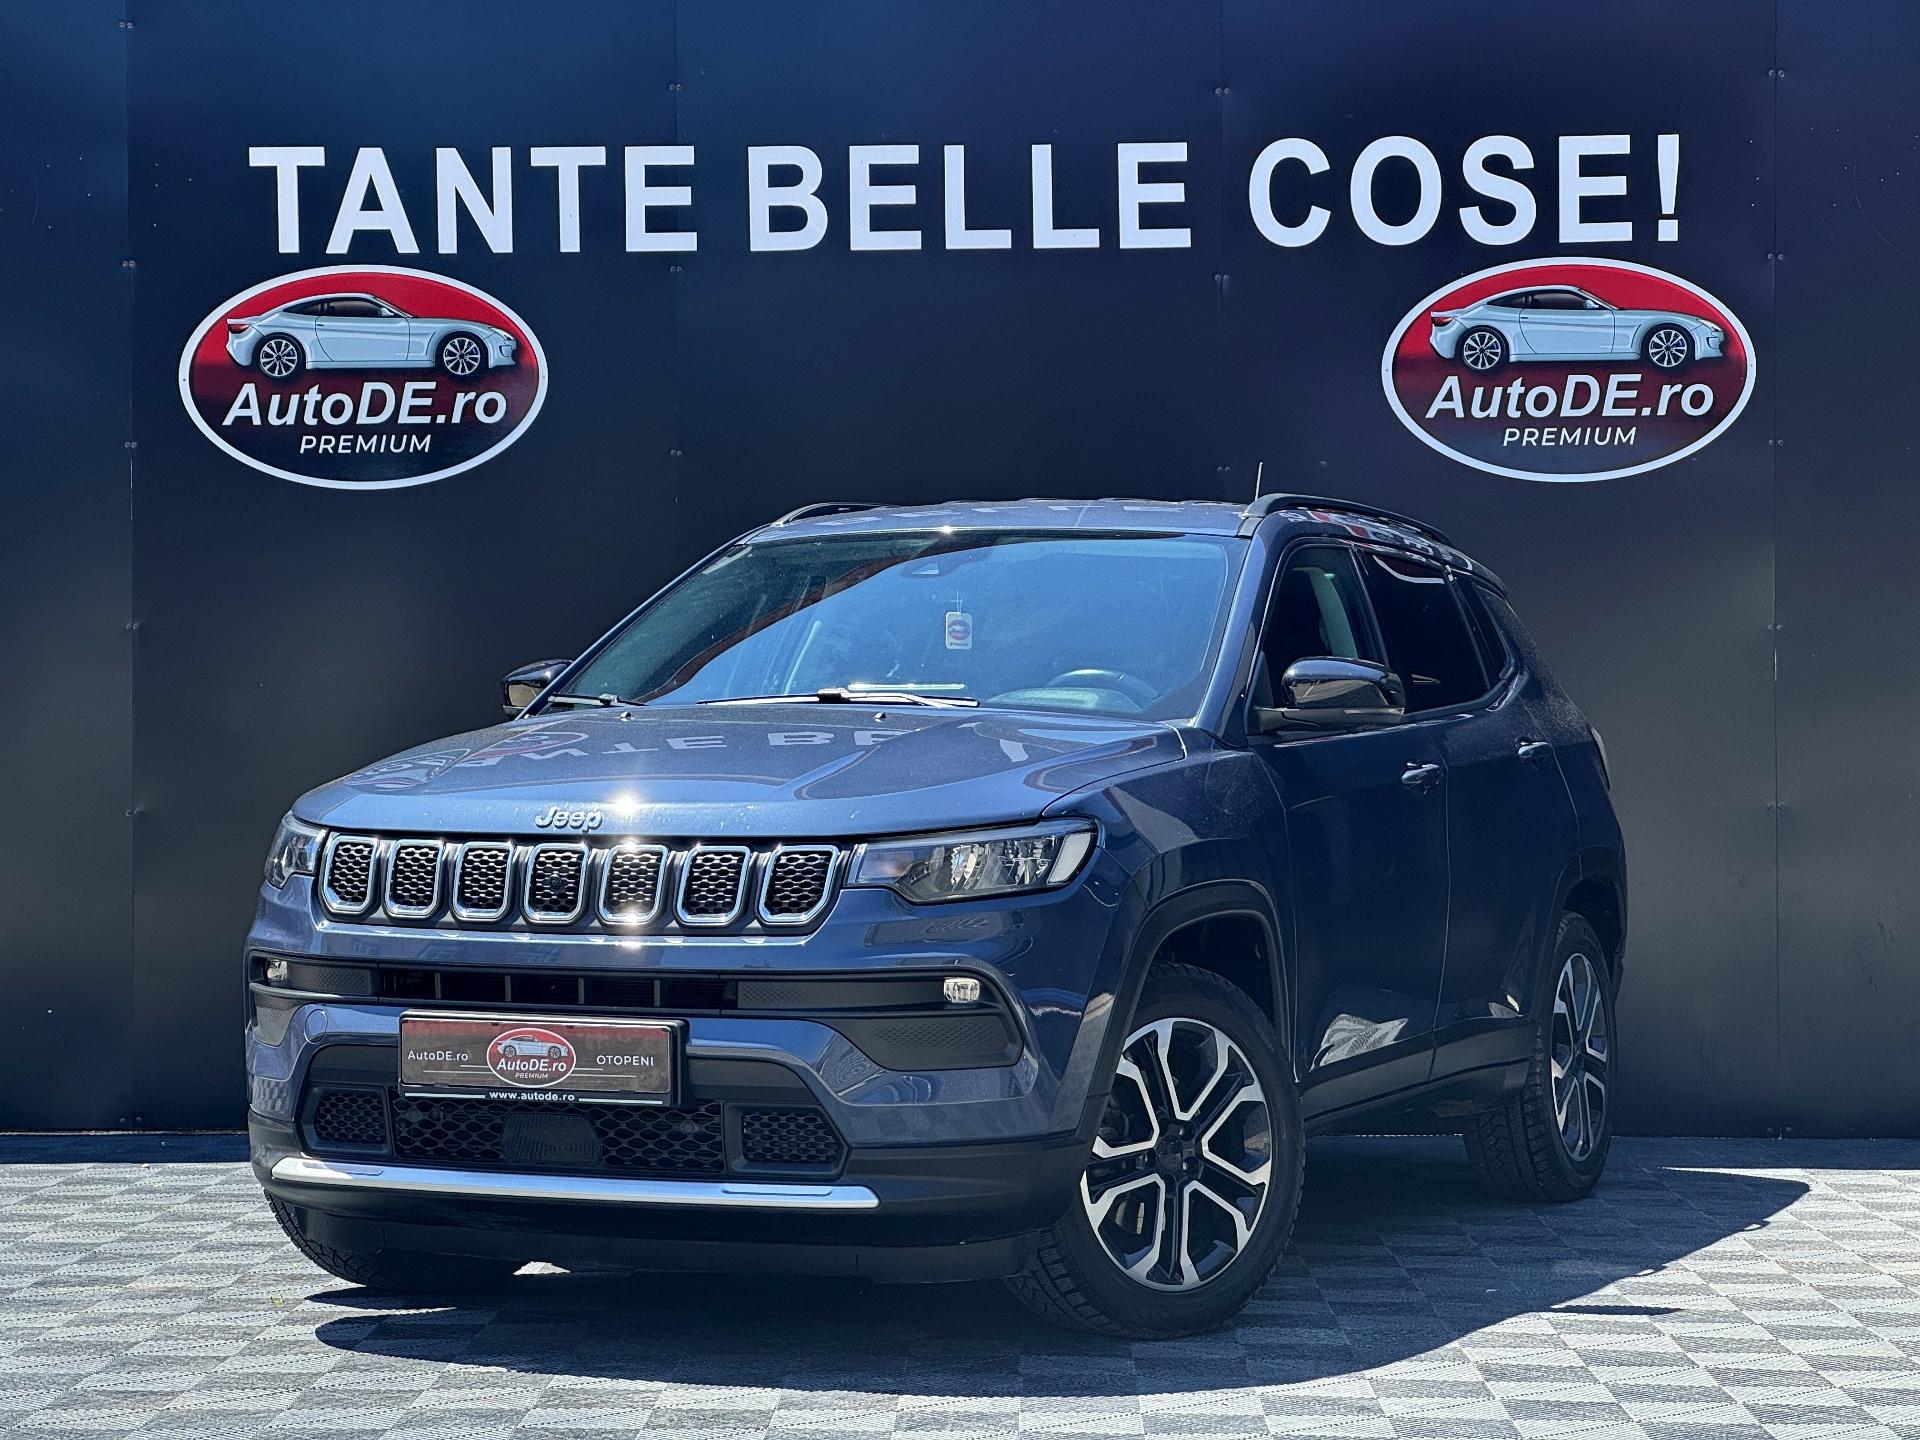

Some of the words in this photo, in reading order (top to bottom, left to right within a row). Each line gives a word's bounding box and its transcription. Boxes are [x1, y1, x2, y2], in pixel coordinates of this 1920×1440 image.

[249, 146, 697, 253] TANTE
[748, 143, 1191, 251] BELLE
[1249, 134, 1679, 247] COSE!
[223, 382, 507, 426] AutoDE.ro
[1426, 374, 1714, 419] AutoDE.ro
[300, 434, 431, 454] PREMIUM
[1503, 427, 1637, 447] PREMIUM
[535, 805, 602, 834] Jeep
[407, 1050, 469, 1062] AutoDE.ro
[497, 1059, 567, 1073] AutoDE.ro
[596, 1054, 655, 1067] OTOPENI
[489, 1091, 576, 1102] www.autode.ro
